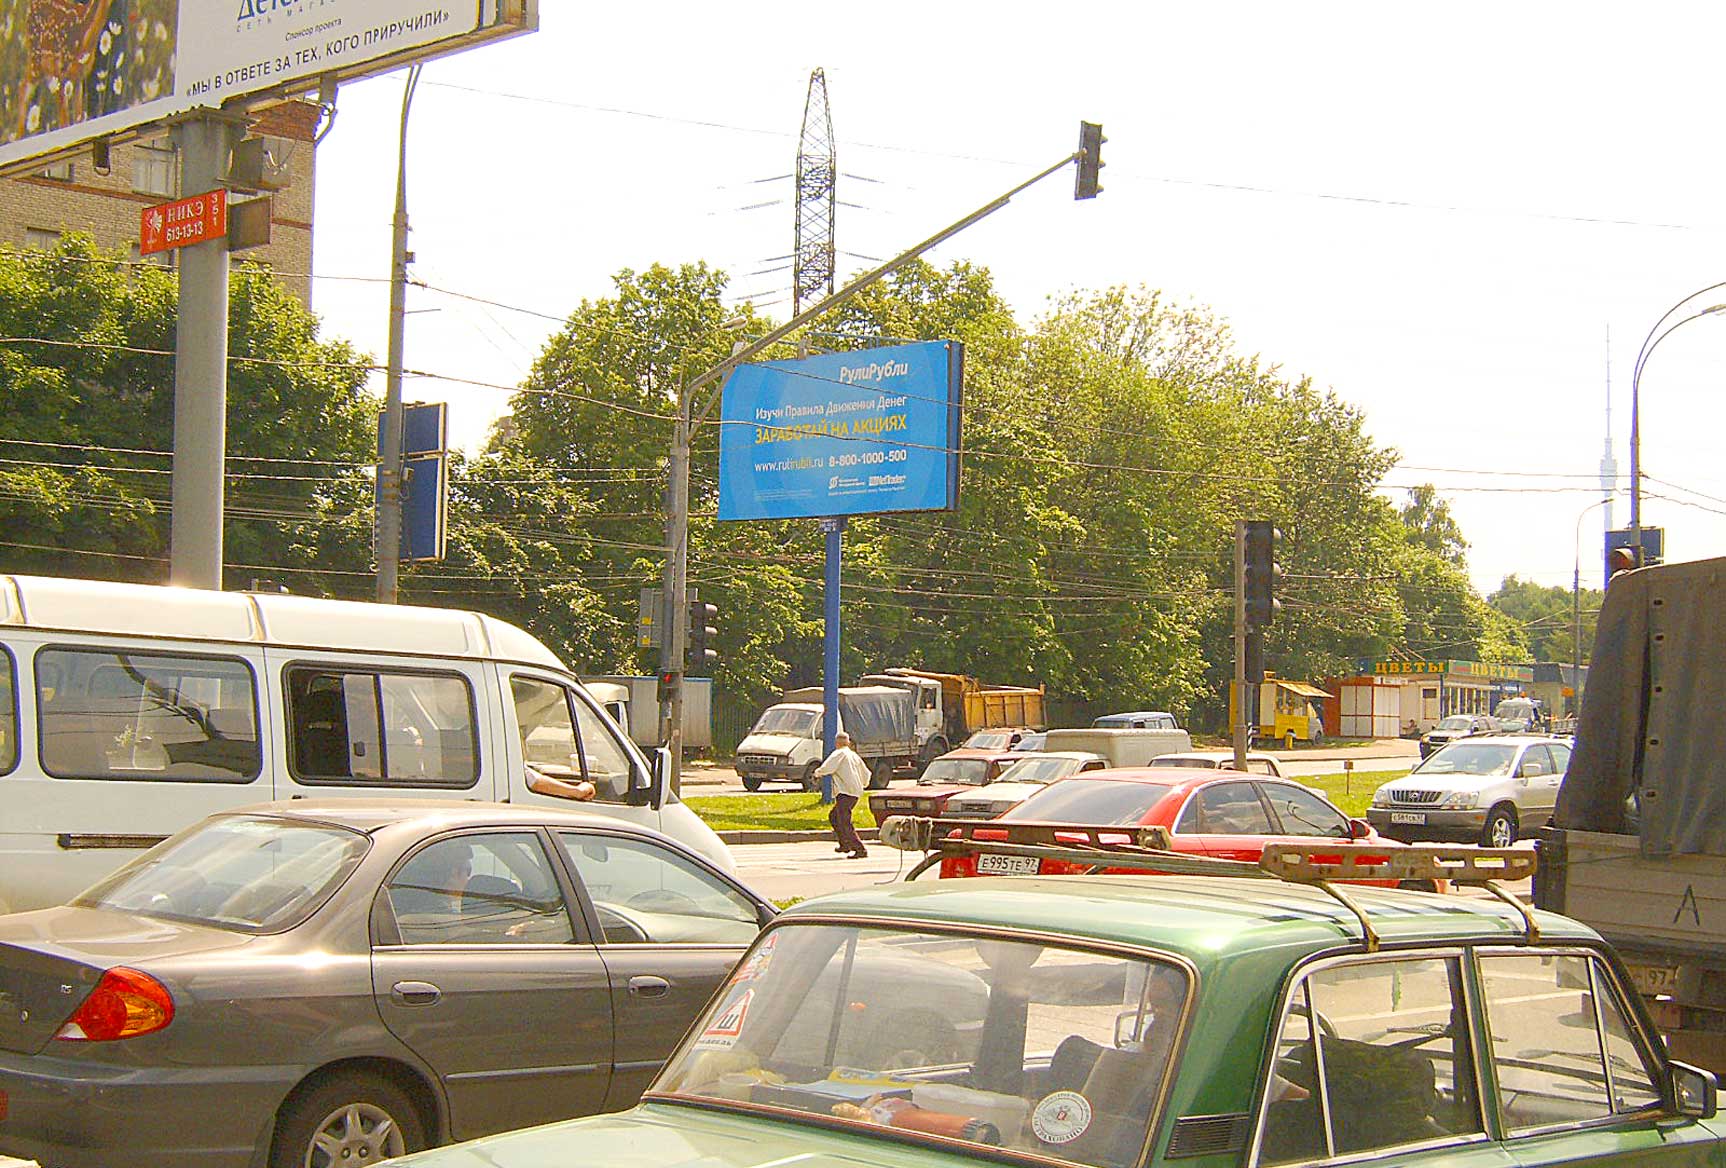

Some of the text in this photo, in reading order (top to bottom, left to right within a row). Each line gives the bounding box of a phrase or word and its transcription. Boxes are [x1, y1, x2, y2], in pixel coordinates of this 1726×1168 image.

[285, 18, 342, 41] Спонсор проекта
[186, 9, 450, 97] «МЫ В ОТВЕТЕ ЗА ТЕХ, КОГО ПРИРУЧИЛИ»
[167, 201, 204, 223] НИКЭ
[166, 220, 204, 243] 613-13-13
[839, 360, 909, 384] РулиРубли
[755, 395, 907, 422] Изучи Правила Движения Денег
[755, 414, 907, 445] ЗАРАБОТАЙ НА АКЦИЯХ
[828, 449, 907, 468] 8-800-1000-500
[1375, 661, 1445, 675] ЦВЕТЫ
[1471, 663, 1520, 679] ЦВЕТЫ
[1025, 858, 1036, 868] 97
[717, 1013, 739, 1029] Ш
